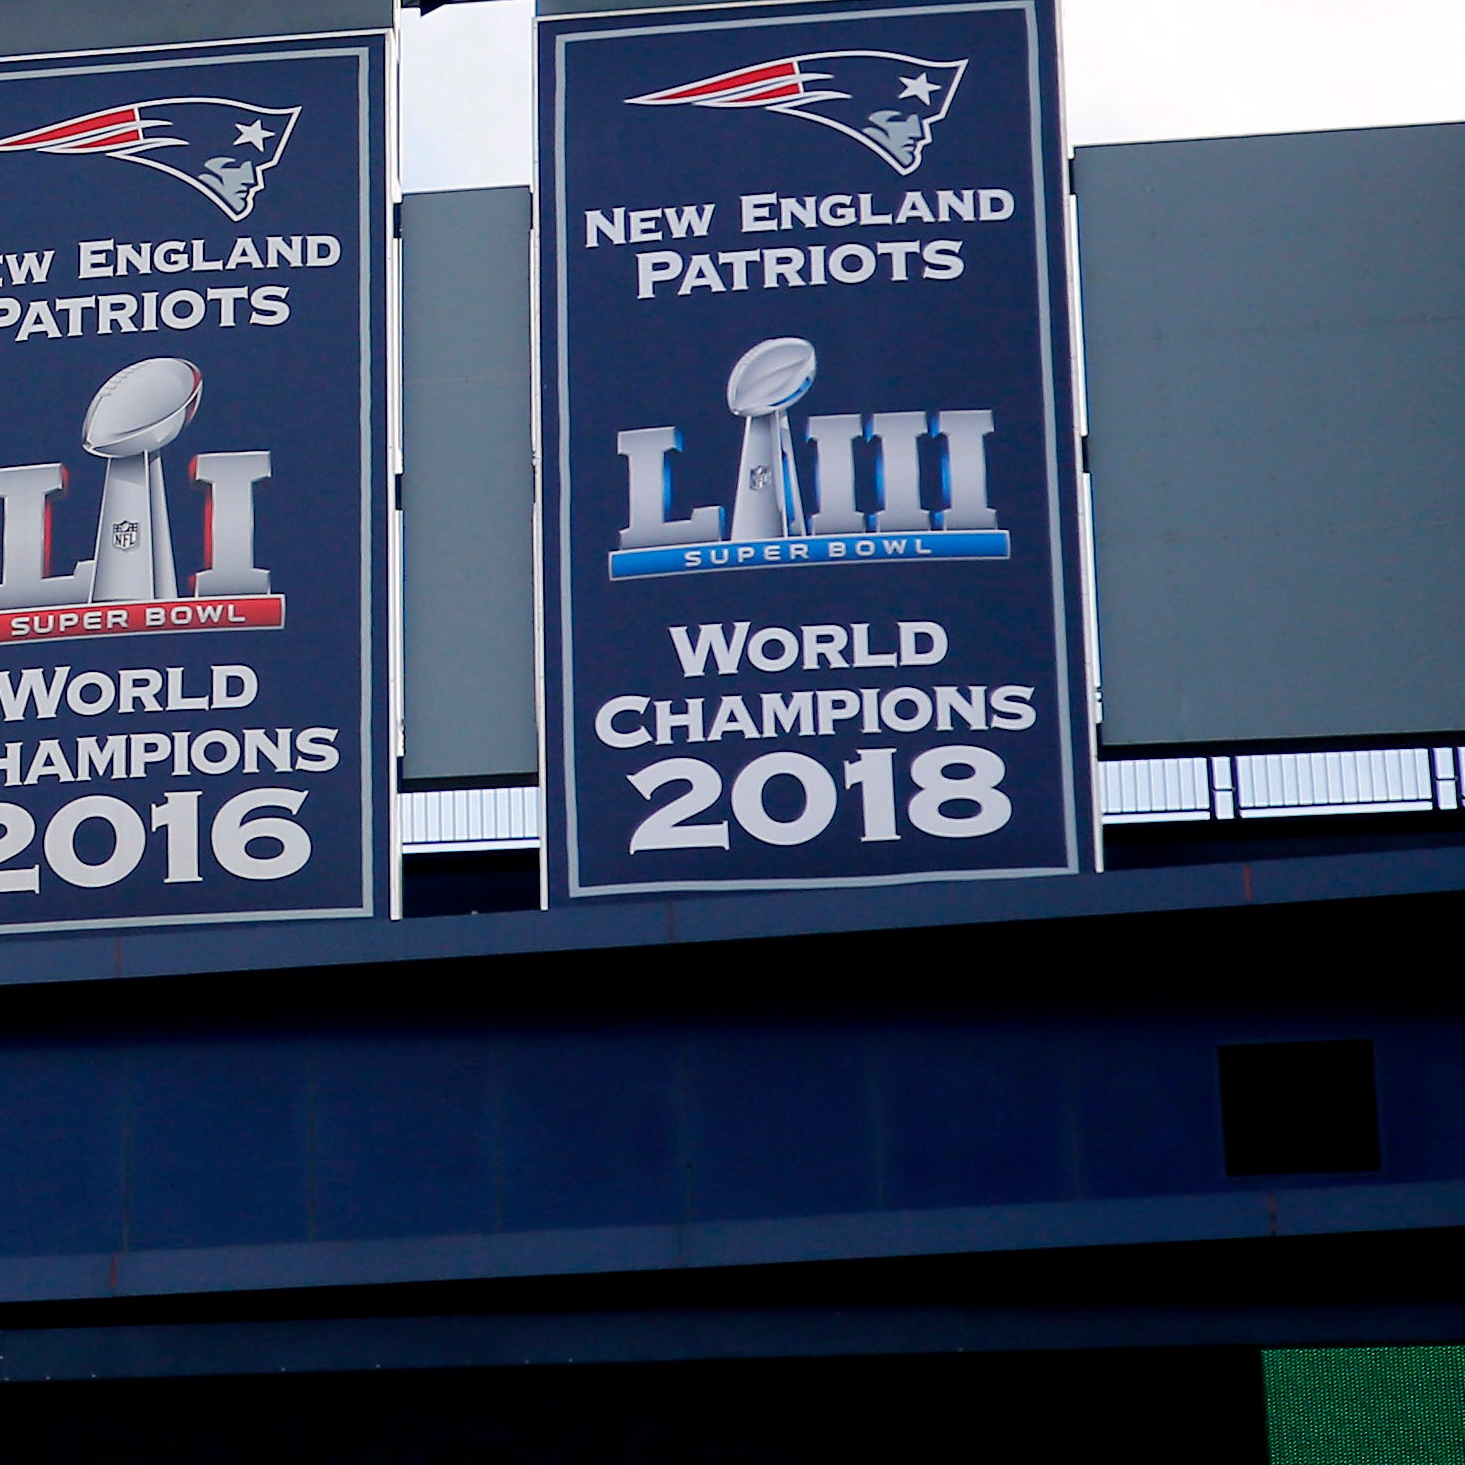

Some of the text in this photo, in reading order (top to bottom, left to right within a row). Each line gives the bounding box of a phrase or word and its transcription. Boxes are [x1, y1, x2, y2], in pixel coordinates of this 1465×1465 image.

[584, 189, 1015, 248] NEW ENGLAND
[78, 235, 341, 279] ENGLAND
[635, 239, 964, 300] PATRIOTS
[114, 533, 136, 547] NFL
[684, 538, 933, 568] SUPER BOWL
[10, 603, 247, 637] SUPER BOWL
[668, 621, 948, 678] WORLD
[595, 685, 1036, 748] CHAMPIONS
[626, 745, 1012, 855] 2018
